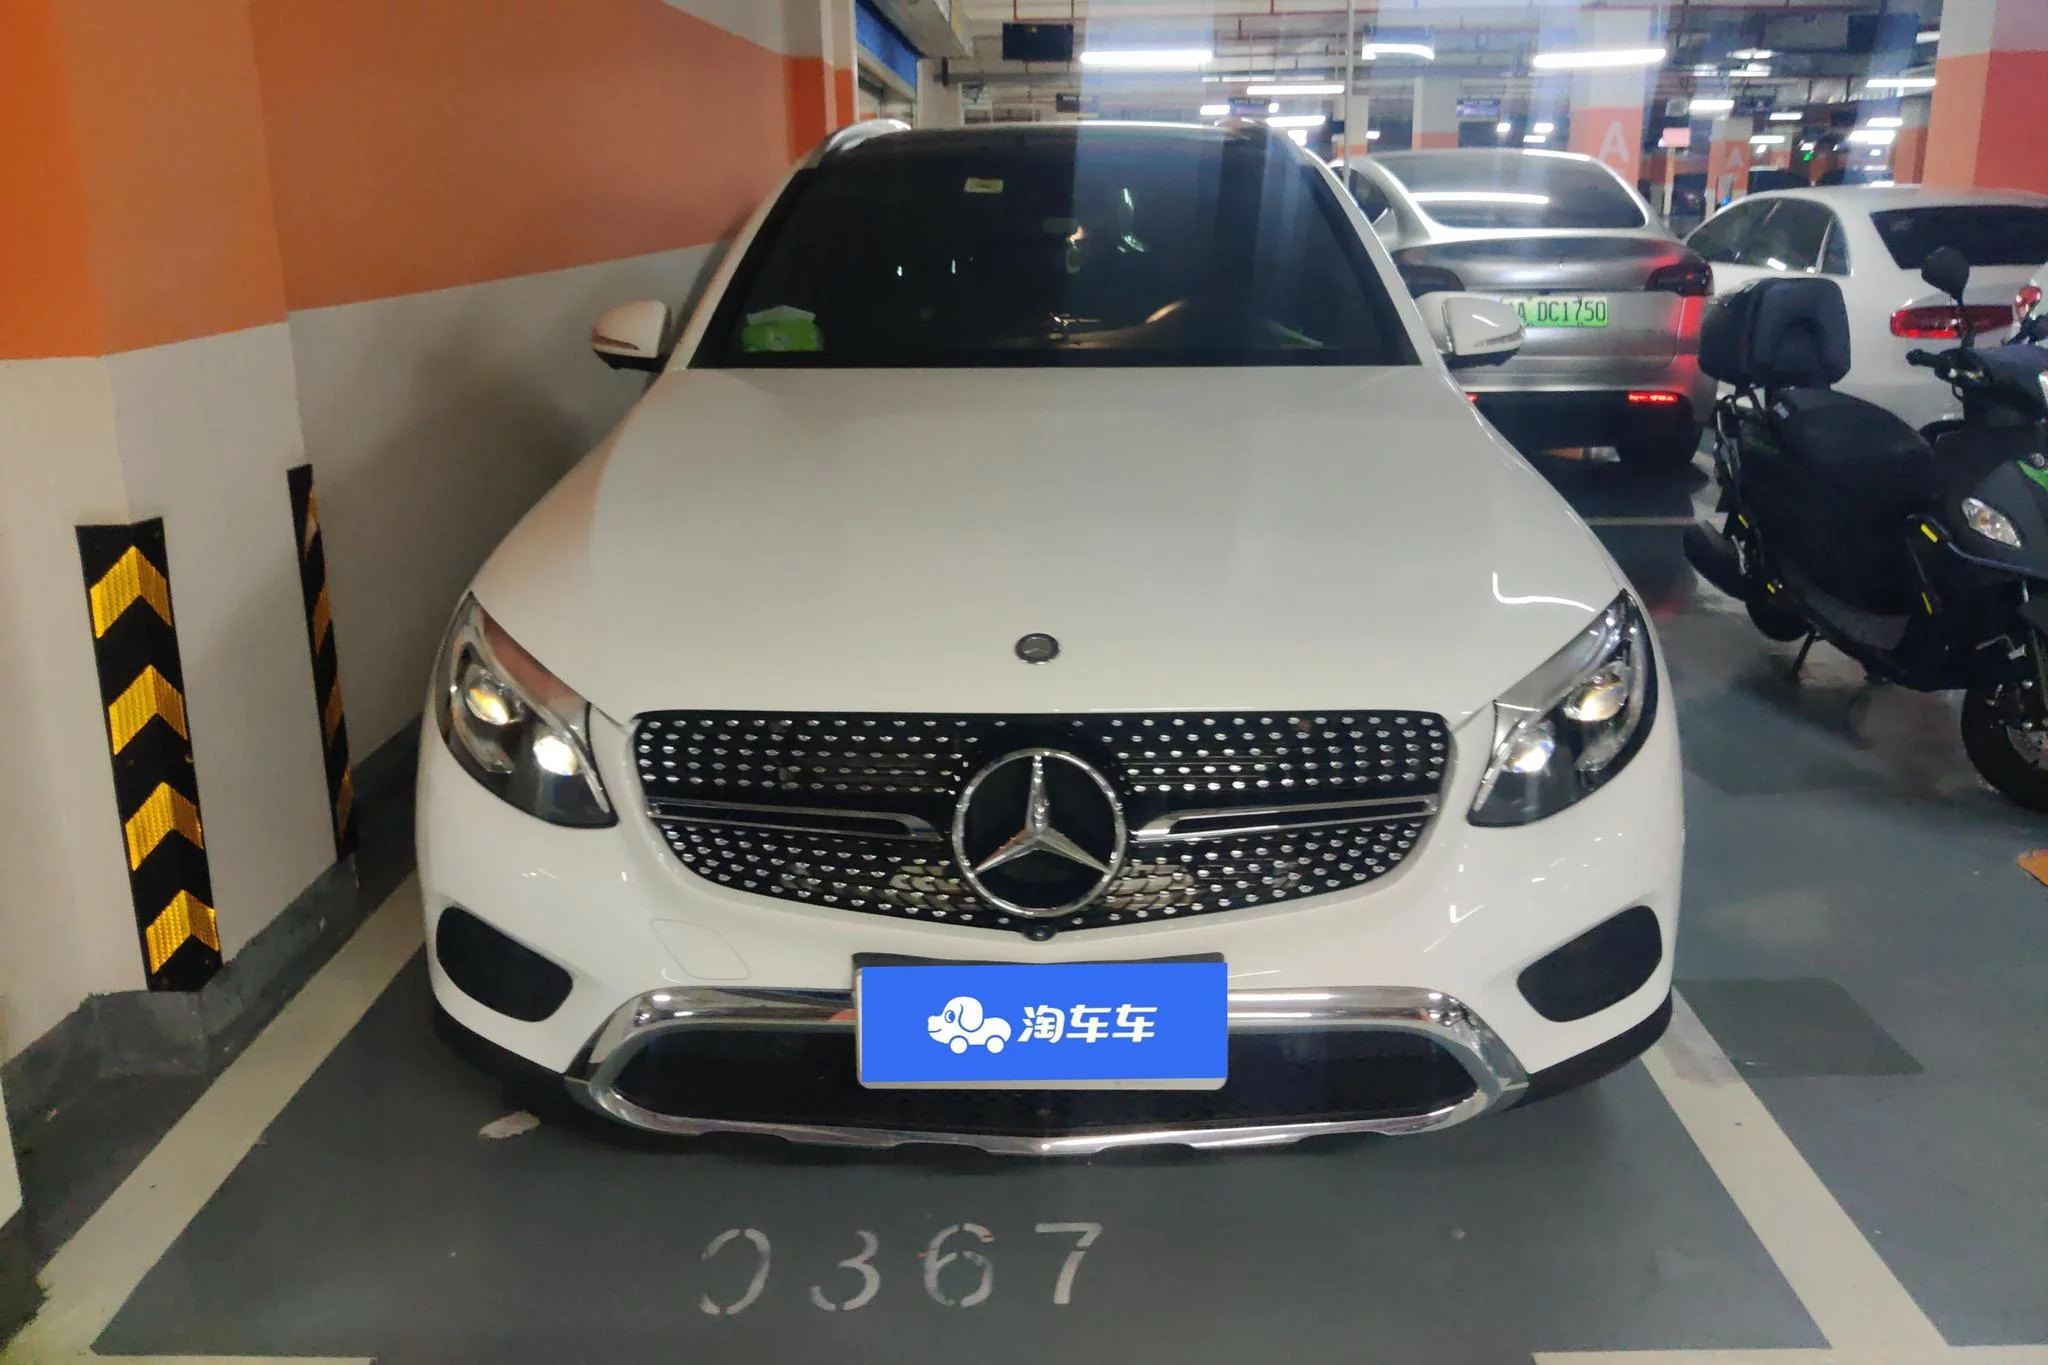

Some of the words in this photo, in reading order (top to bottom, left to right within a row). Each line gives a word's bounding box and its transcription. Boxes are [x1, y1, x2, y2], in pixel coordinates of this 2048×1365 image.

[1599, 121, 1630, 163] A
[1537, 301, 1606, 322] DC1750
[700, 1222, 1103, 1315] 0367
